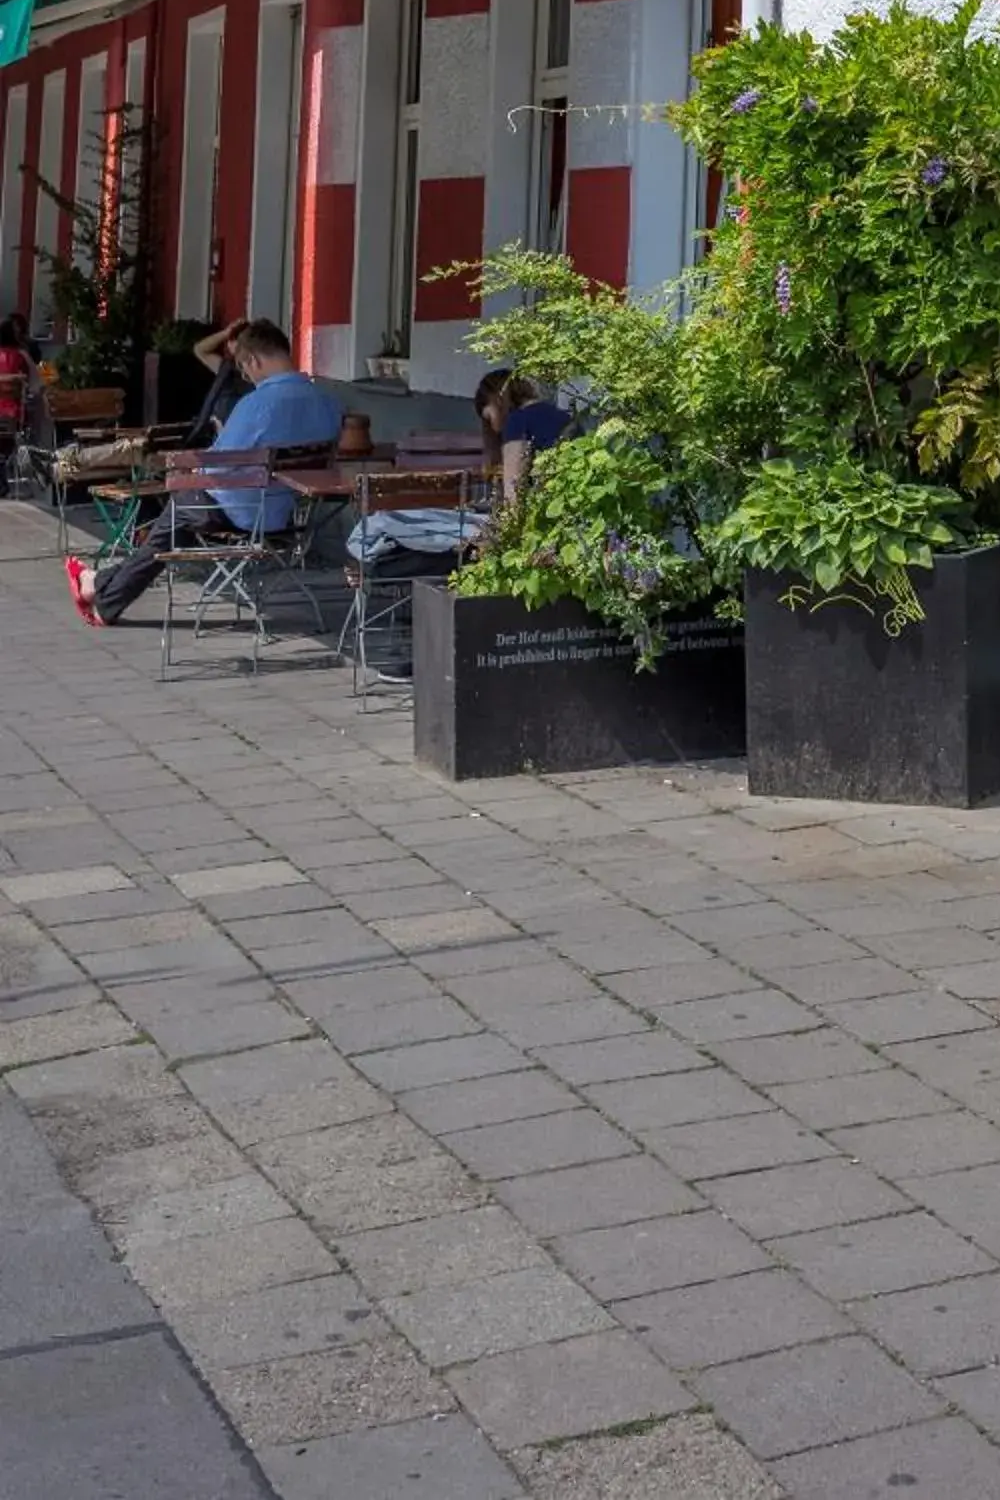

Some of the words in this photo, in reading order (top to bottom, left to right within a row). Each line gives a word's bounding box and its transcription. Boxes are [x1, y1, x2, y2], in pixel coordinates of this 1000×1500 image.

[495, 632, 516, 647] Der
[517, 628, 540, 645] Hof
[498, 647, 555, 669] prohibited
